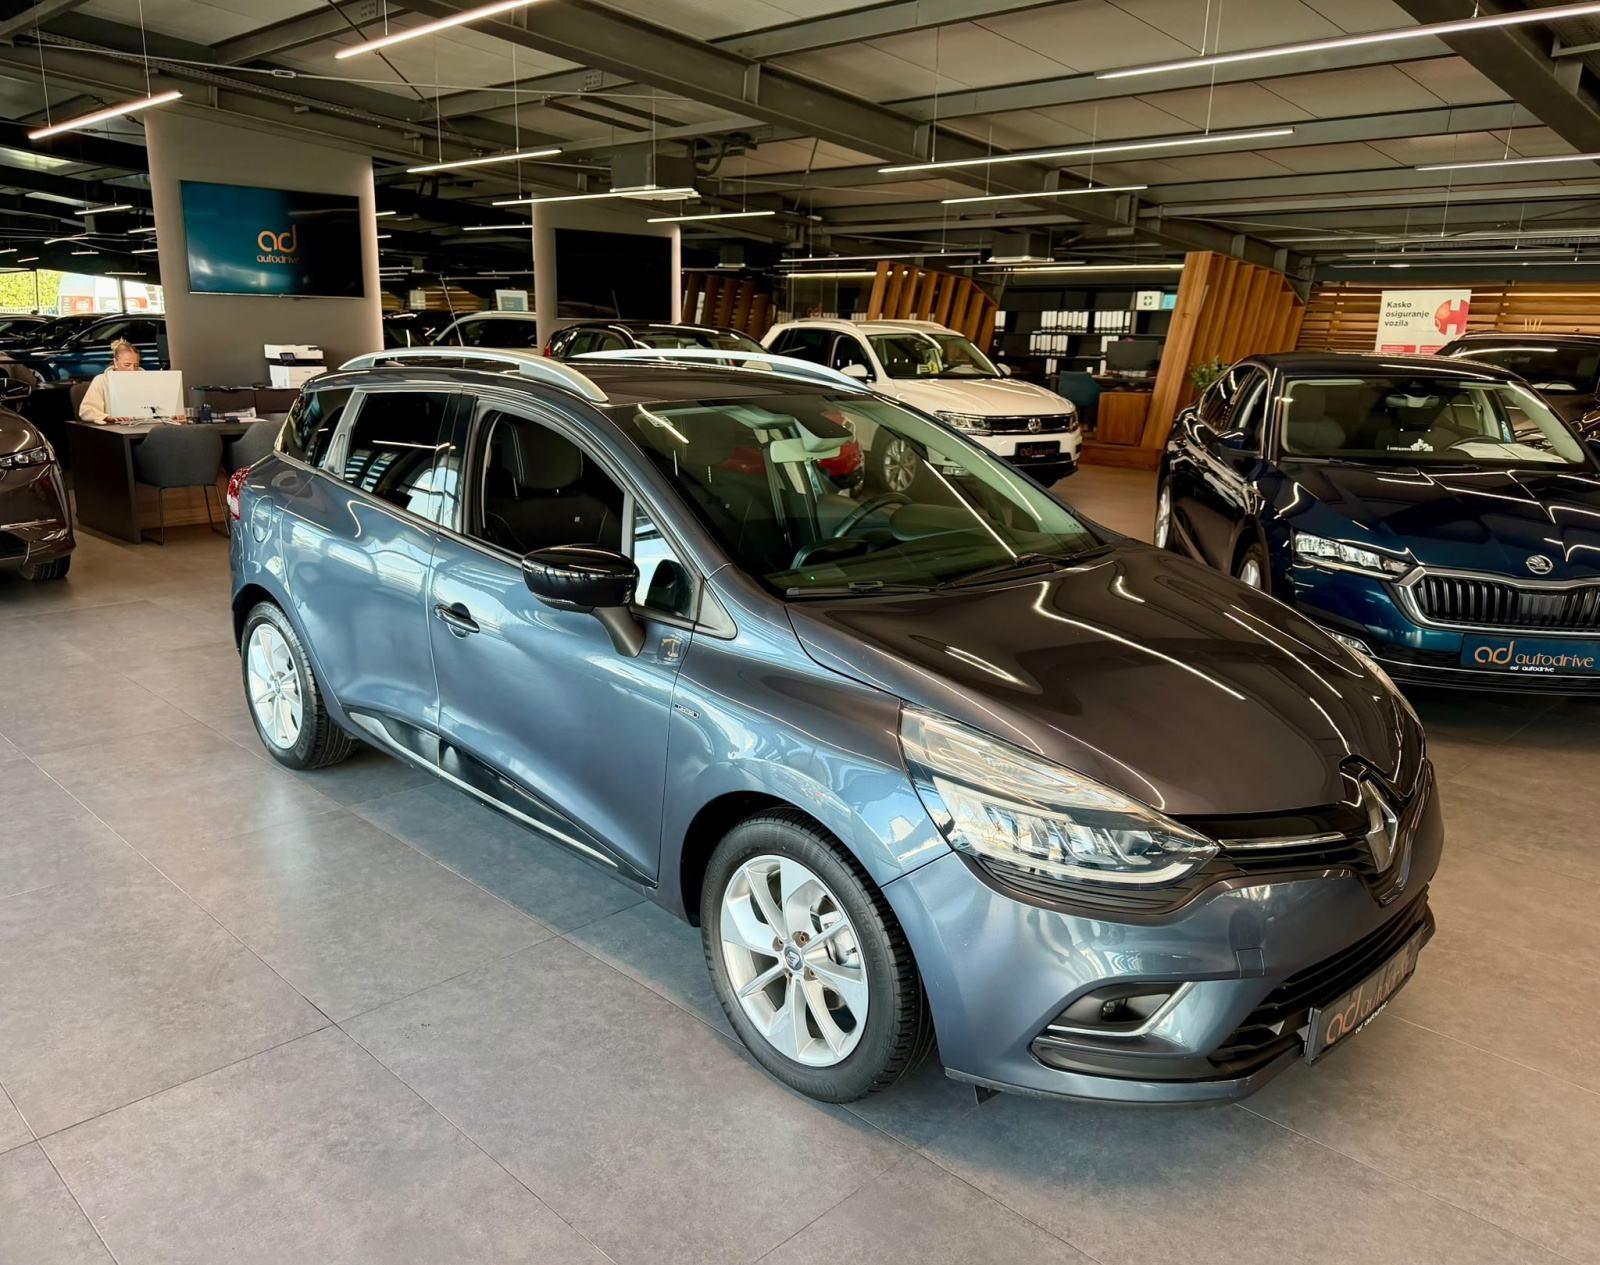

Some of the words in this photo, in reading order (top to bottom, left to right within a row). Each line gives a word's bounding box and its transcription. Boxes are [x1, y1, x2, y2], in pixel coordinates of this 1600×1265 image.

[257, 224, 297, 253] ad
[1386, 301, 1412, 309] Kasko
[1385, 310, 1430, 319] osiguranje
[1384, 319, 1409, 327] vozila
[1474, 640, 1515, 665] ad
[1515, 652, 1594, 668] autodrive
